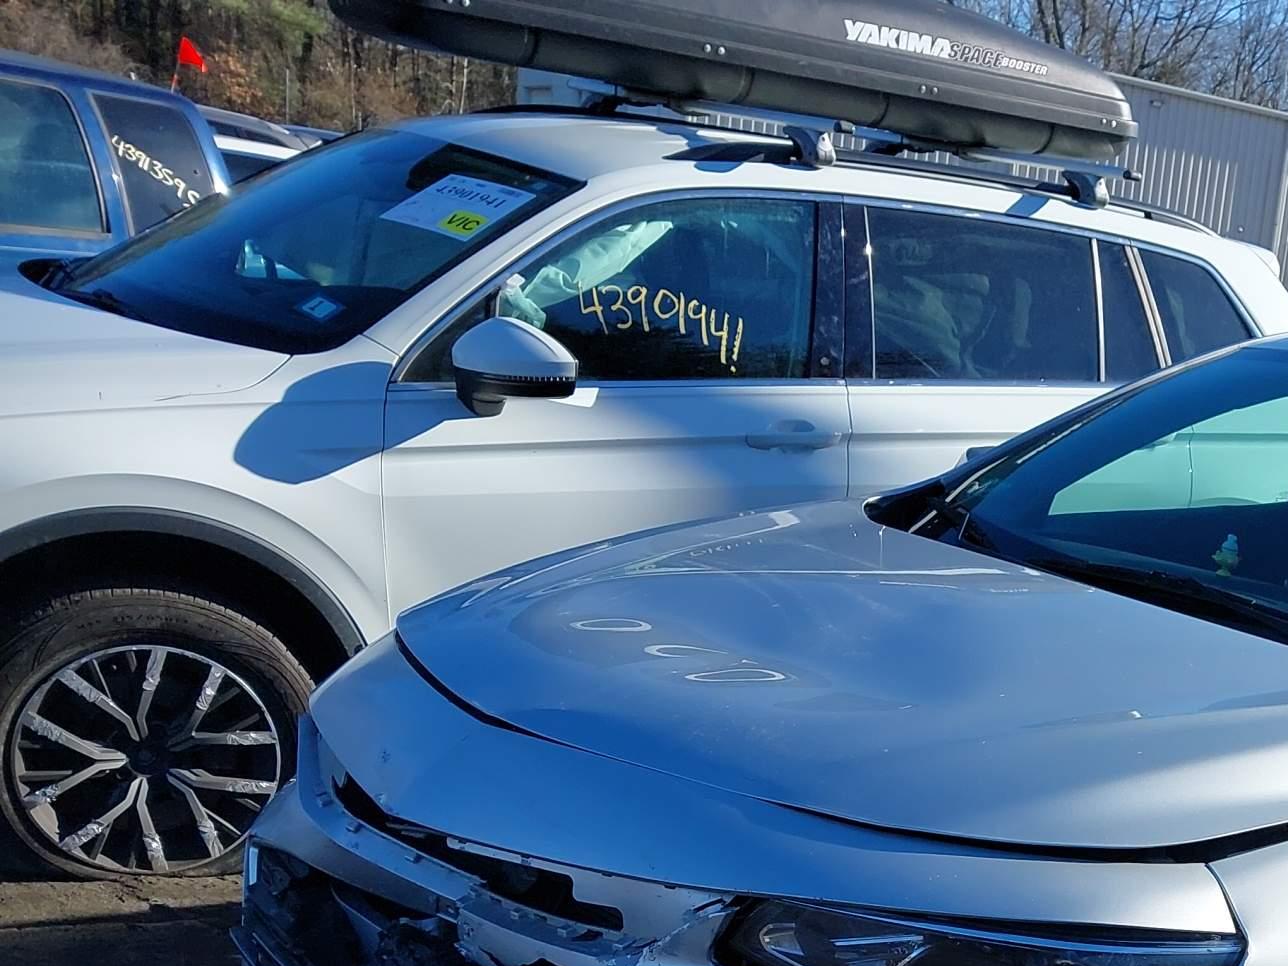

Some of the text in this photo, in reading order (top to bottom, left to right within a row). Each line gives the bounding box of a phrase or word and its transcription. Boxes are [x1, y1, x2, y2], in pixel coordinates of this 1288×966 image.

[843, 19, 1049, 76] YAKIMA SPACE BOOSTER
[447, 213, 480, 231] VIC
